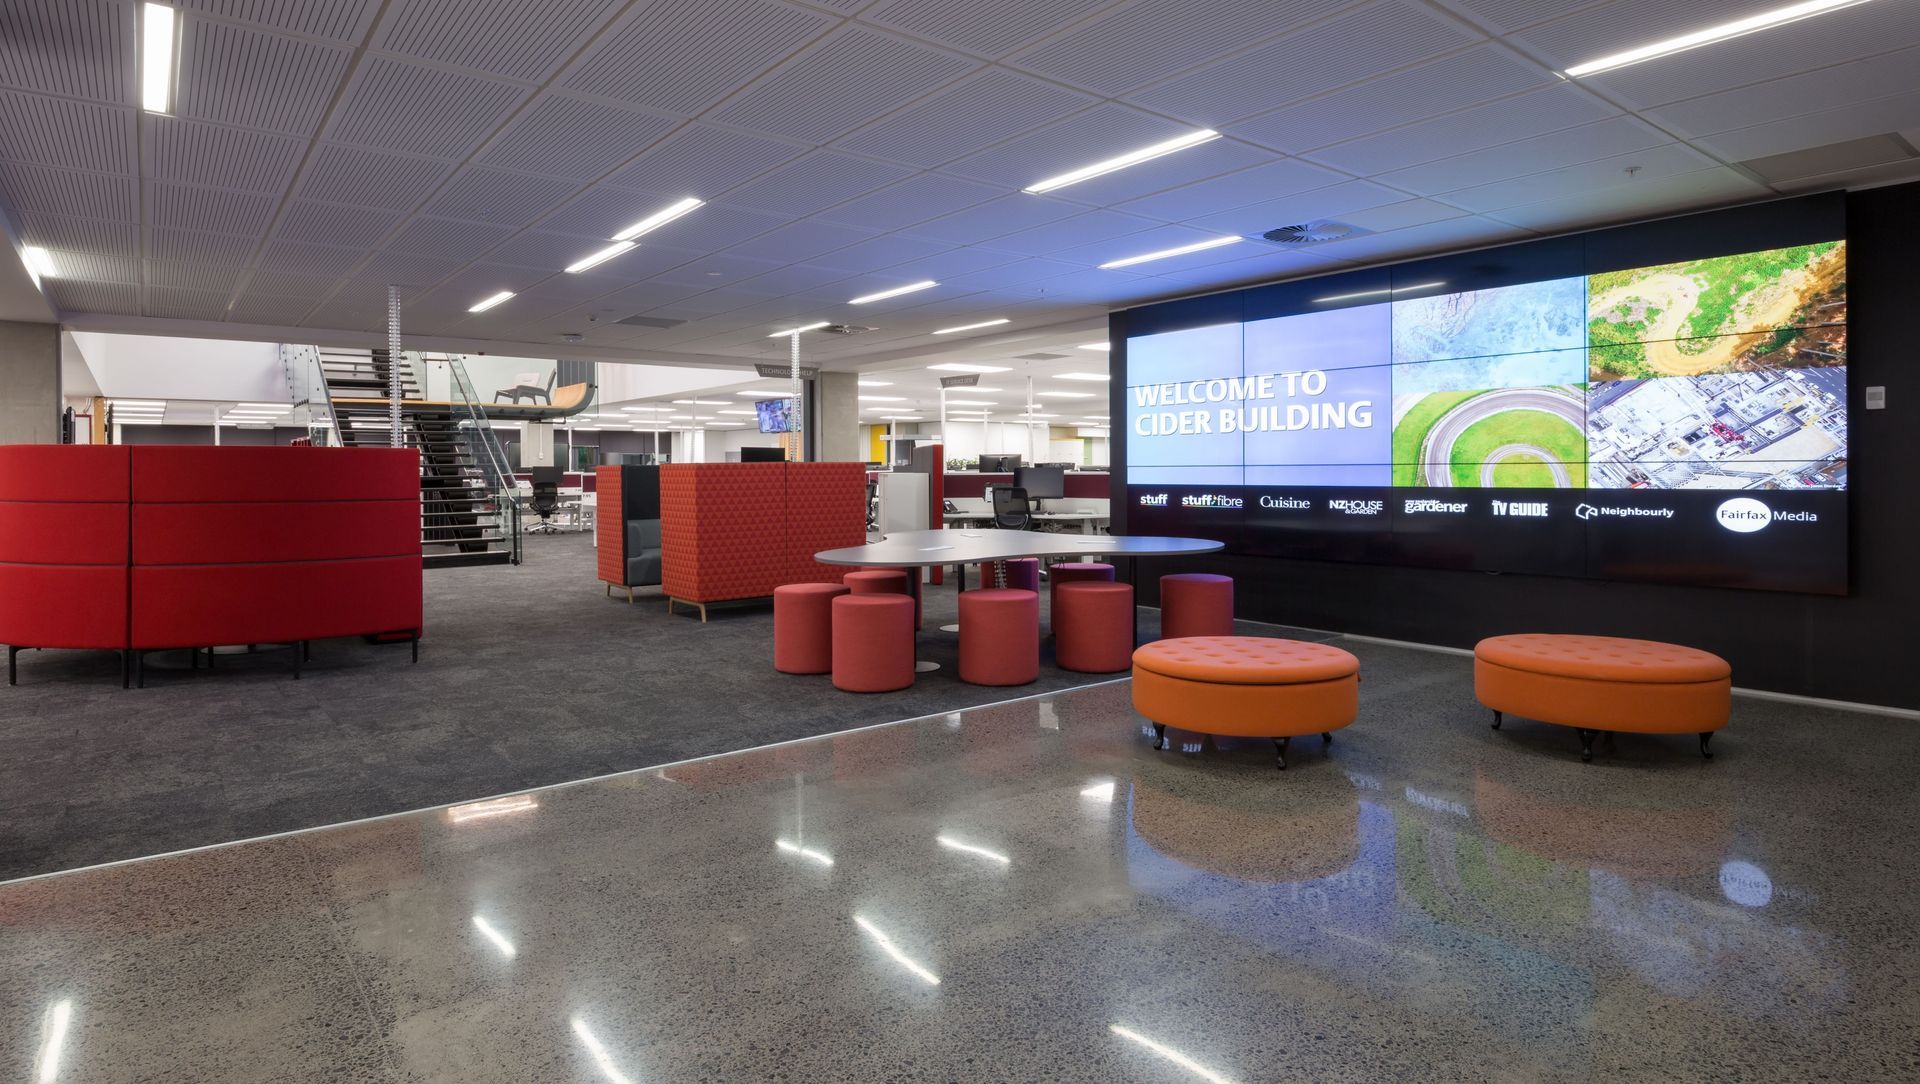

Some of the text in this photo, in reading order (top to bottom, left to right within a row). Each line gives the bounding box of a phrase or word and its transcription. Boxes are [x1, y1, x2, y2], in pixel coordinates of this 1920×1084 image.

[761, 367, 794, 377] TECHNOLO
[1134, 369, 1328, 408] WELCOME TO
[1135, 400, 1374, 437] CIDER BUILDING
[1140, 494, 1168, 504] stuff
[1182, 495, 1243, 507] stuff fibre
[1260, 495, 1311, 509] Cuisine
[1404, 500, 1468, 513] gardener
[1509, 502, 1548, 516] GUIDE
[1601, 507, 1674, 518] Neighbourly
[1721, 510, 1818, 522] Fairfax Media
